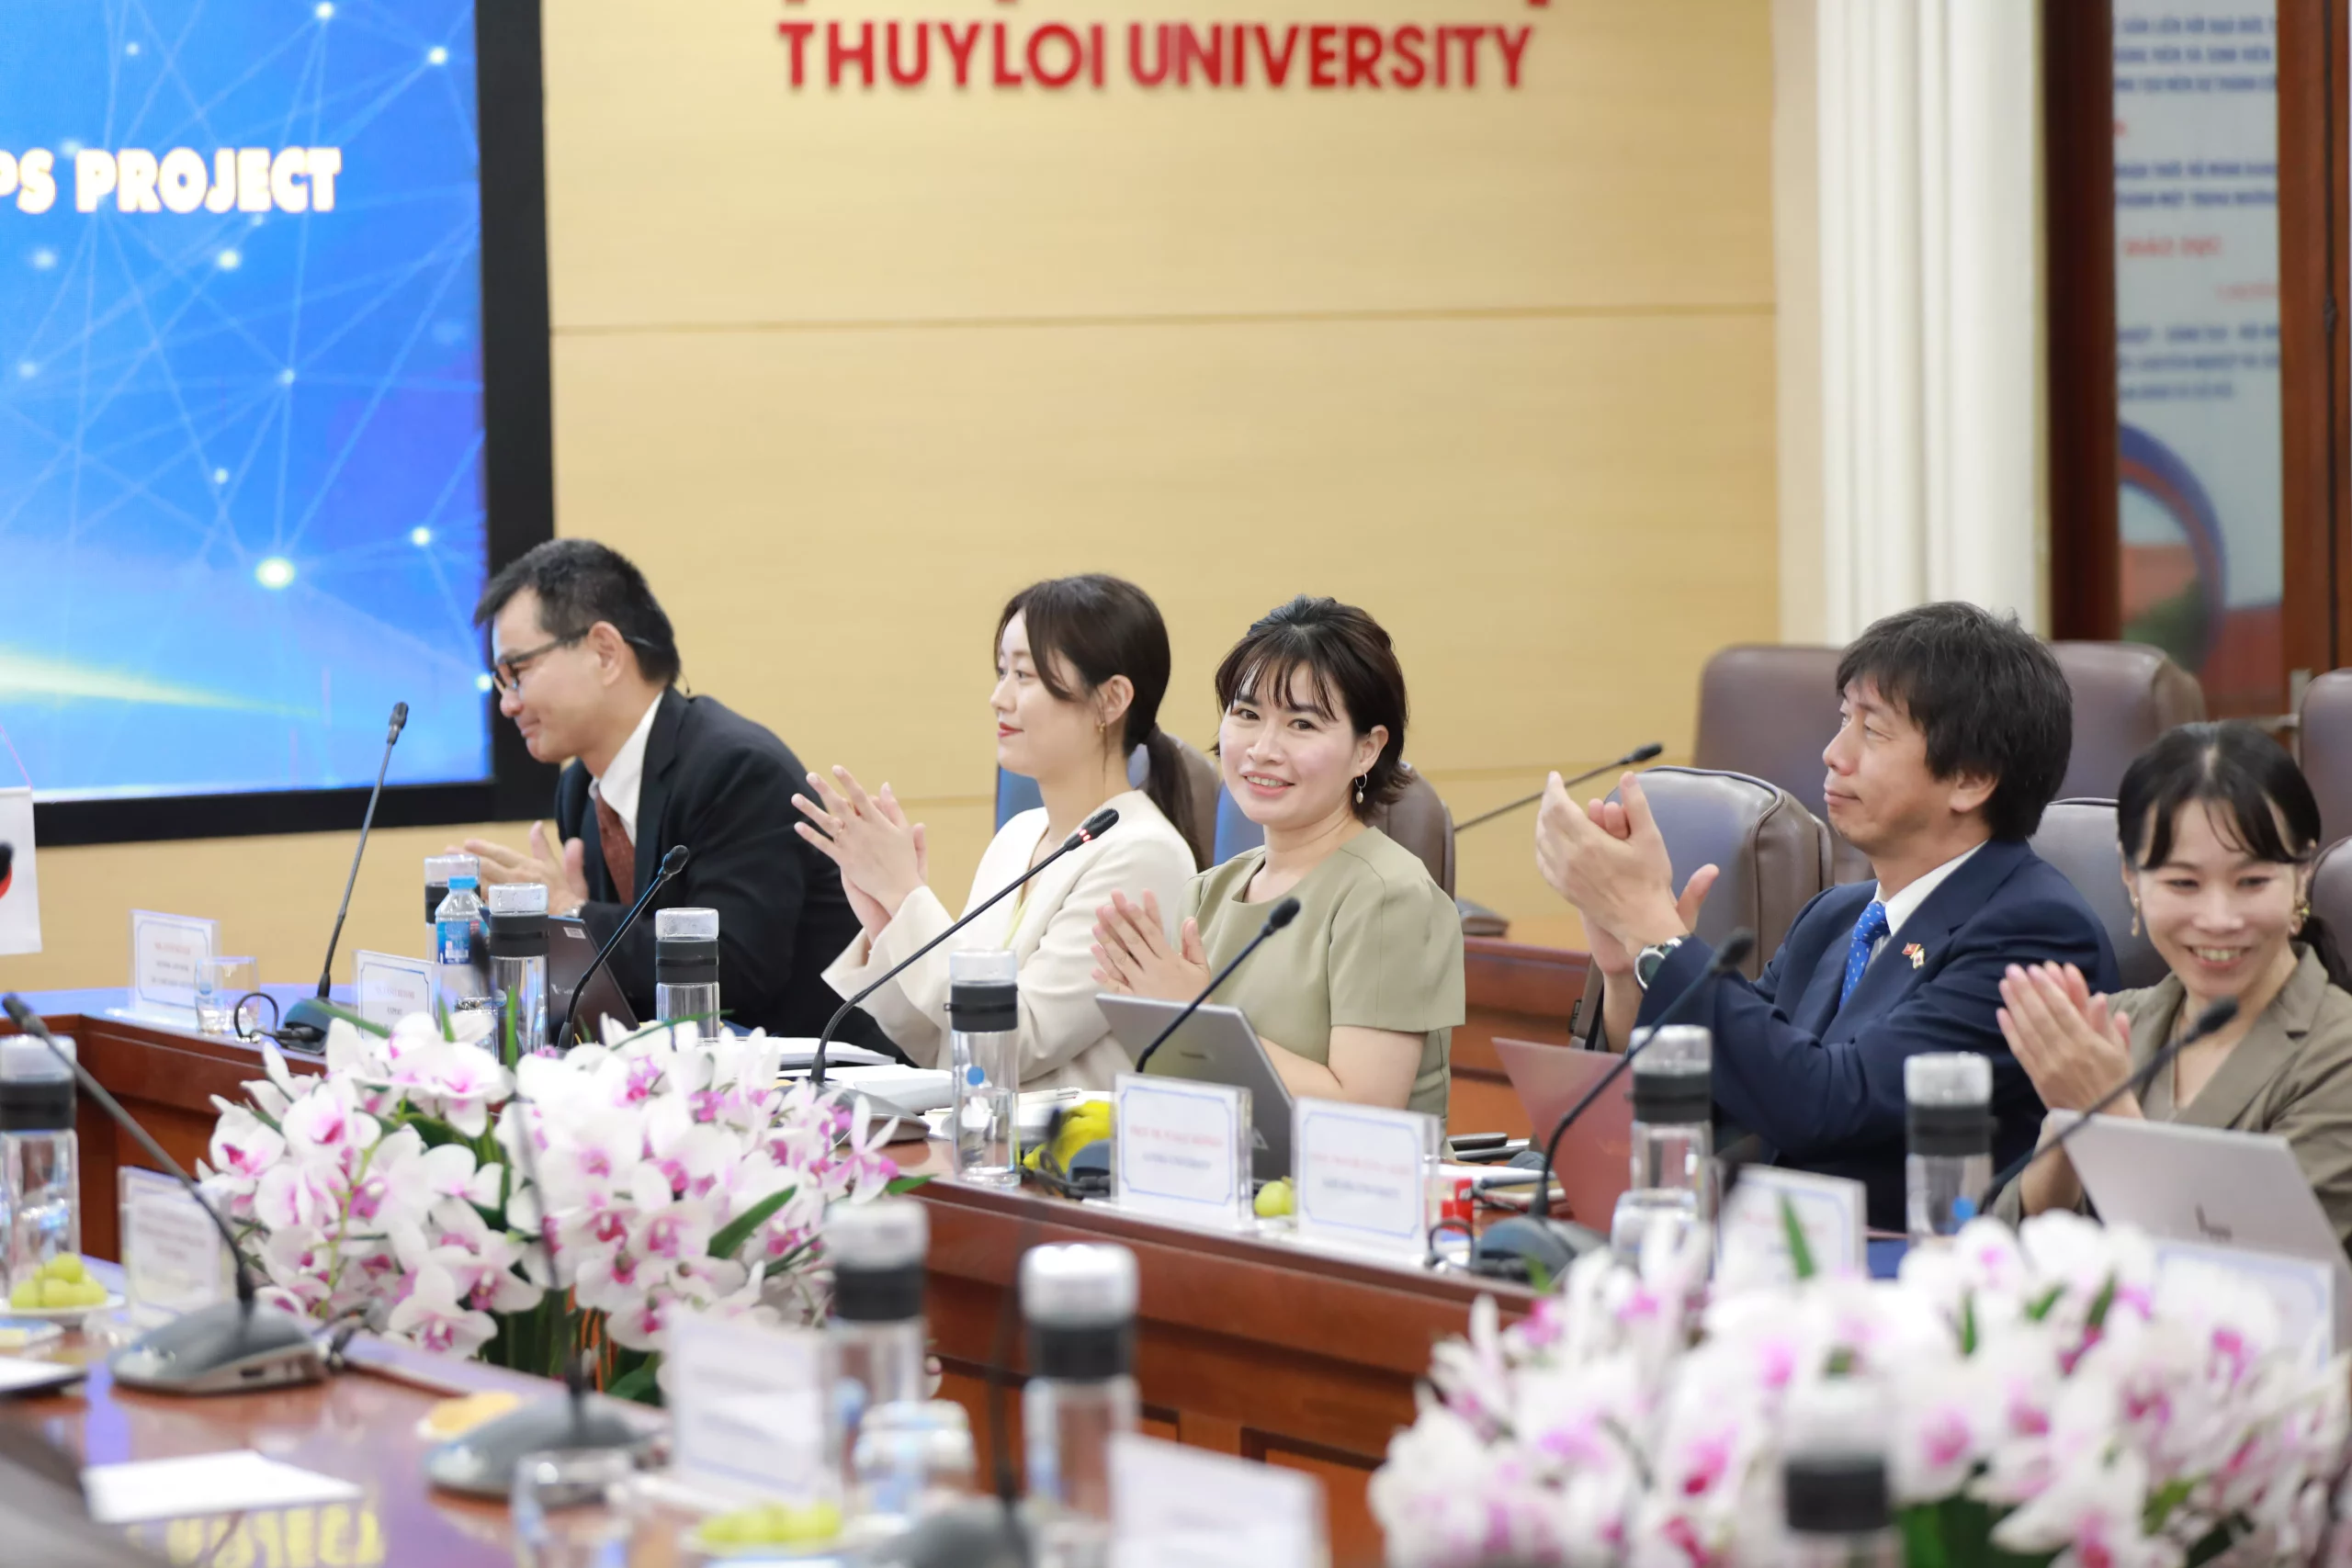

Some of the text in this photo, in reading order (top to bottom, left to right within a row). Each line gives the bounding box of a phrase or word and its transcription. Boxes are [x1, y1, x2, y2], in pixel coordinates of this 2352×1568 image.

[778, 21, 1532, 89] THUYLOI UNIVERSITY
[75, 147, 341, 214] PROJECT
